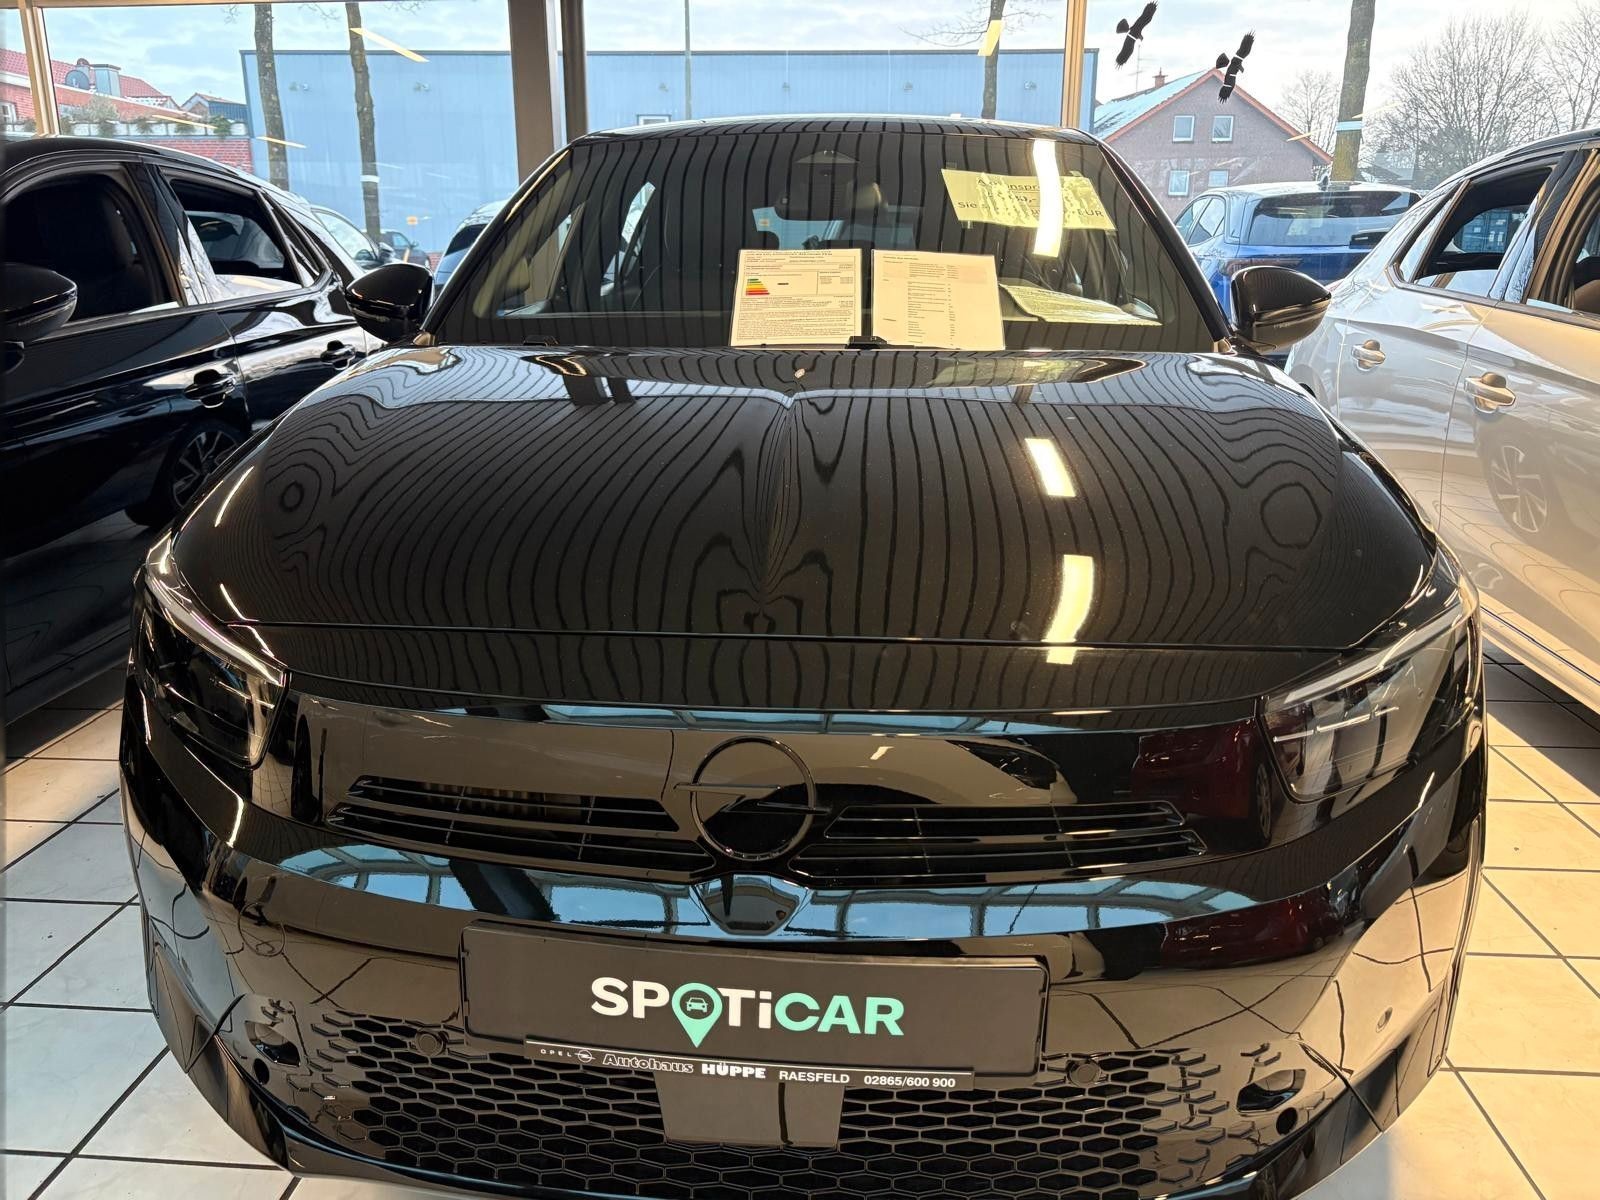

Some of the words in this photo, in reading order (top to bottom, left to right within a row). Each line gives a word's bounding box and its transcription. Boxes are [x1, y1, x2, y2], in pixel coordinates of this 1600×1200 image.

[540, 1048, 572, 1058] OPEL
[602, 1053, 694, 1074] Autohaus
[701, 1062, 766, 1079] HÜPPE
[778, 1070, 850, 1084] RAESFELD
[863, 1075, 930, 1088] 02865/600
[932, 1077, 956, 1088] 900
